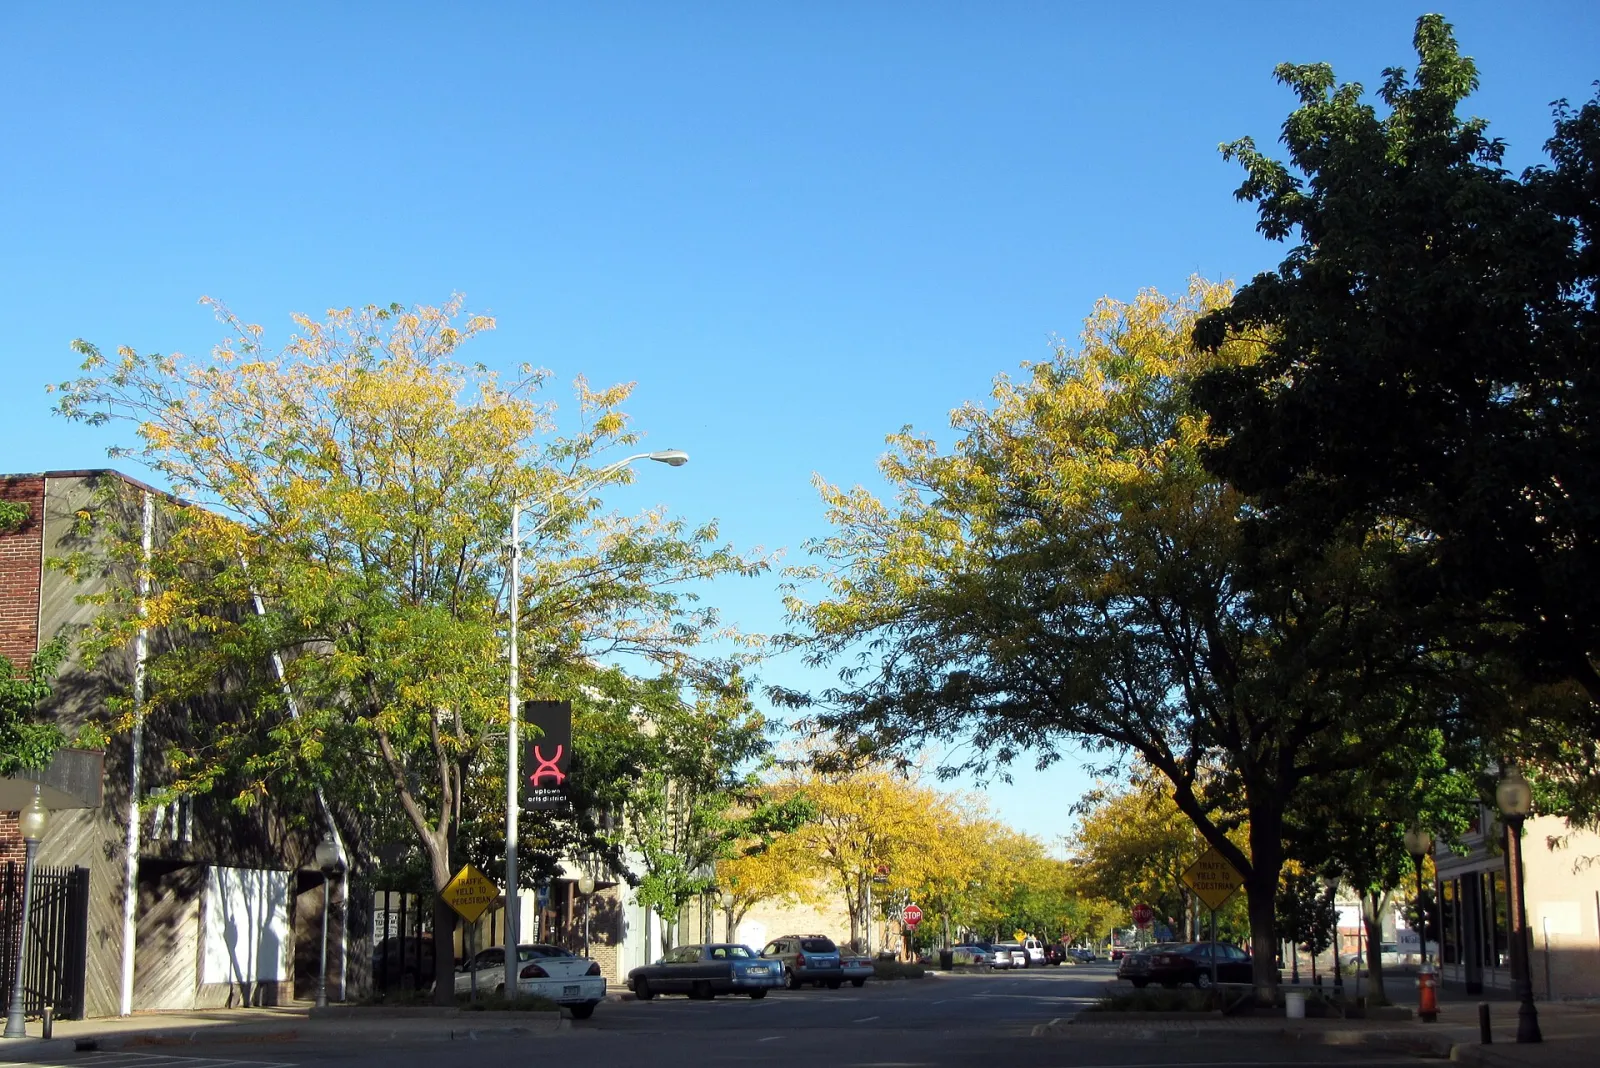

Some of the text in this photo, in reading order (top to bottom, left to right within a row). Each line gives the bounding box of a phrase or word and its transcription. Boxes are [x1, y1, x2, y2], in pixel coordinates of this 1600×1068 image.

[1199, 861, 1228, 869] TRAFFIC
[1196, 872, 1230, 880] YIELD TO
[458, 877, 484, 886] TRAFFIC
[1193, 882, 1234, 890] PEDESTRIAN
[455, 886, 487, 895] YIELD TO
[451, 896, 491, 905] PEDESTRIAN
[904, 911, 921, 919] STOP
[1134, 910, 1151, 918] STOP
